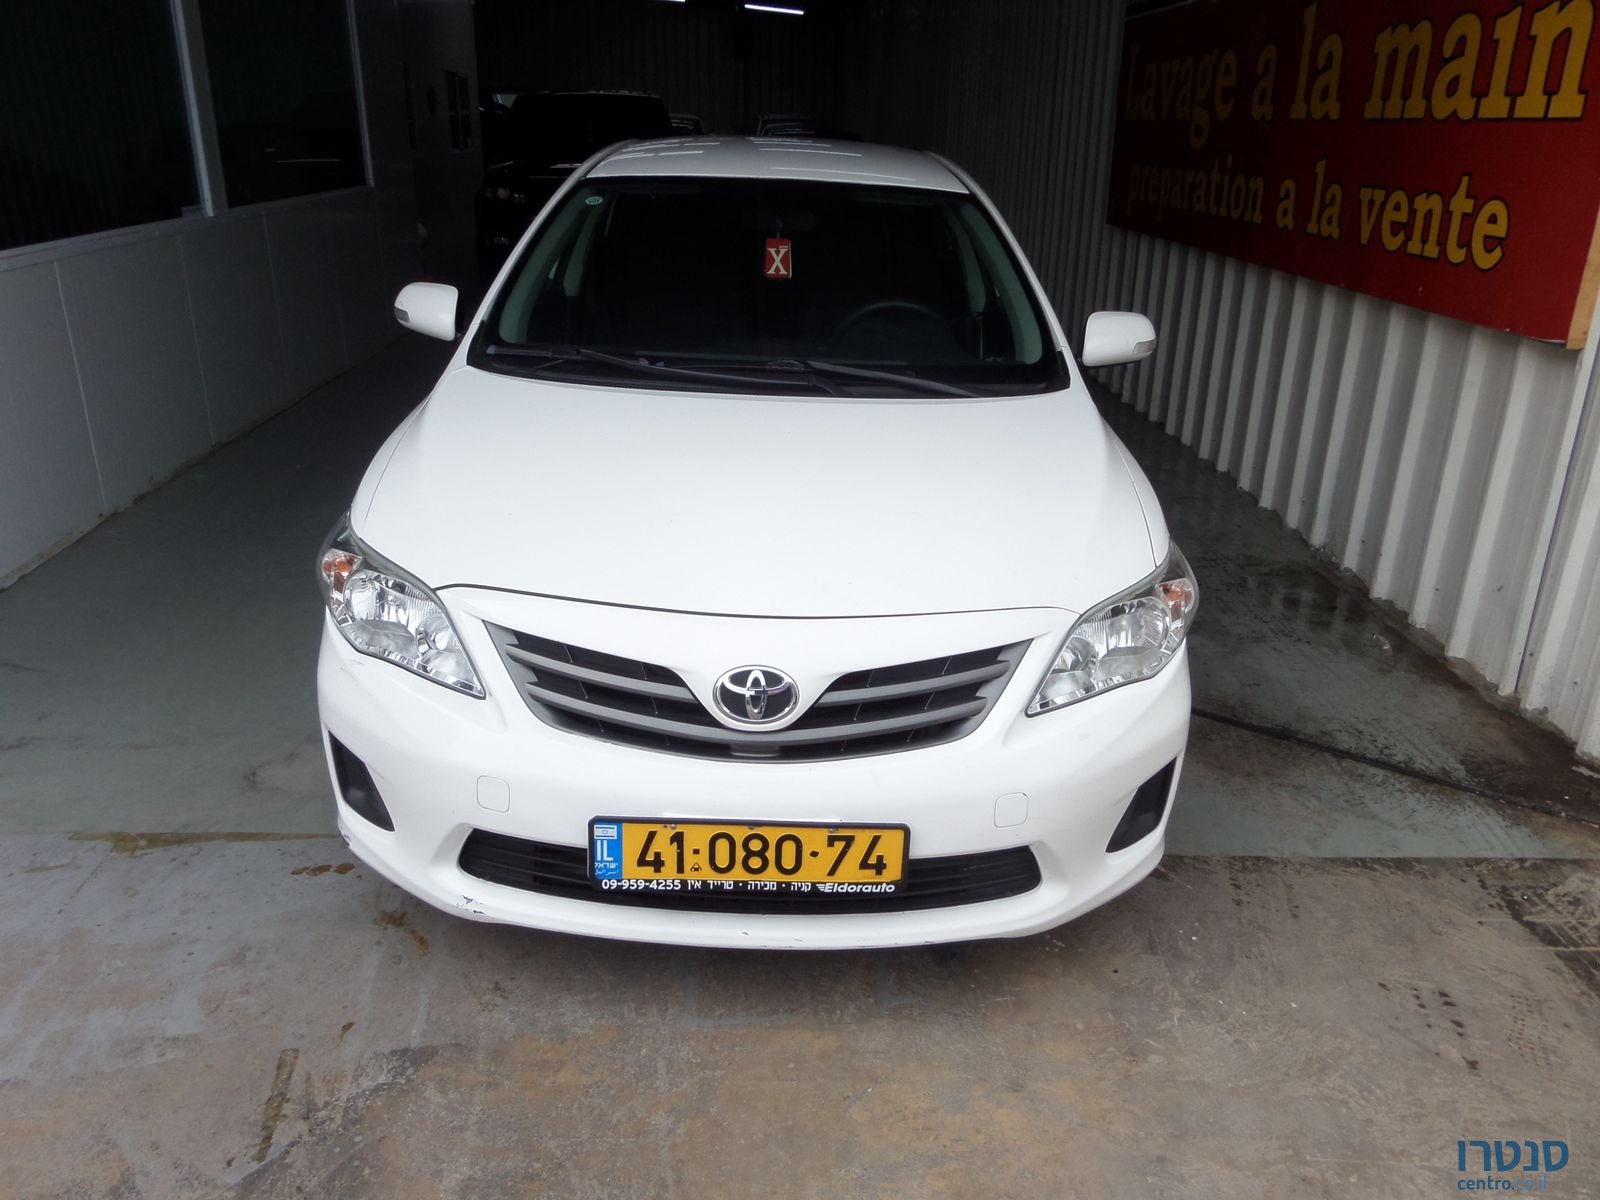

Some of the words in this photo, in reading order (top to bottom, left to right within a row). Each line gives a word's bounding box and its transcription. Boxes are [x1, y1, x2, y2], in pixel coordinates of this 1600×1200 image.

[1122, 42, 1238, 150] Lavage
[1289, 1, 1344, 121] la
[1363, 0, 1595, 120] main
[1123, 152, 1265, 225] preparation
[1275, 177, 1297, 231] a
[1305, 158, 1343, 241] la
[1358, 173, 1509, 270] vente
[596, 839, 614, 861] IL
[601, 879, 681, 890] 09-959-4255
[824, 882, 896, 893] Eldorauto
